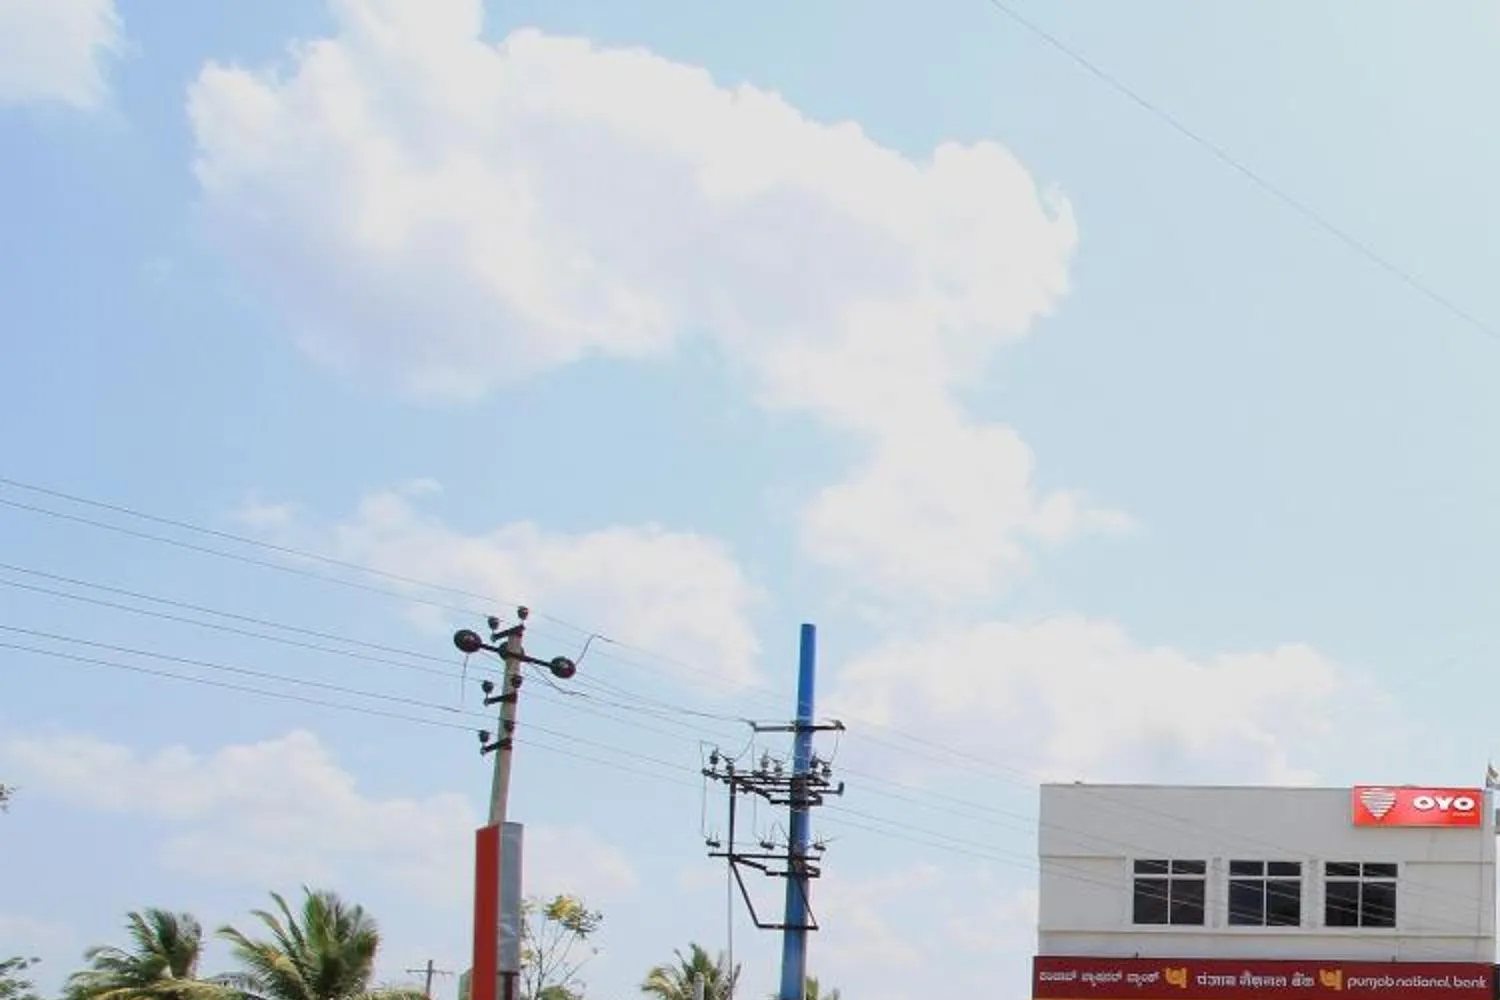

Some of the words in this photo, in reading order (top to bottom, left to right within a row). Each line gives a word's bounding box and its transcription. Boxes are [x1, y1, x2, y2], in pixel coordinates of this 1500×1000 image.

[1412, 795, 1475, 811] OYO
[1347, 975, 1395, 990] punjab
[1396, 975, 1451, 988] national
[1453, 975, 1488, 989] bank
